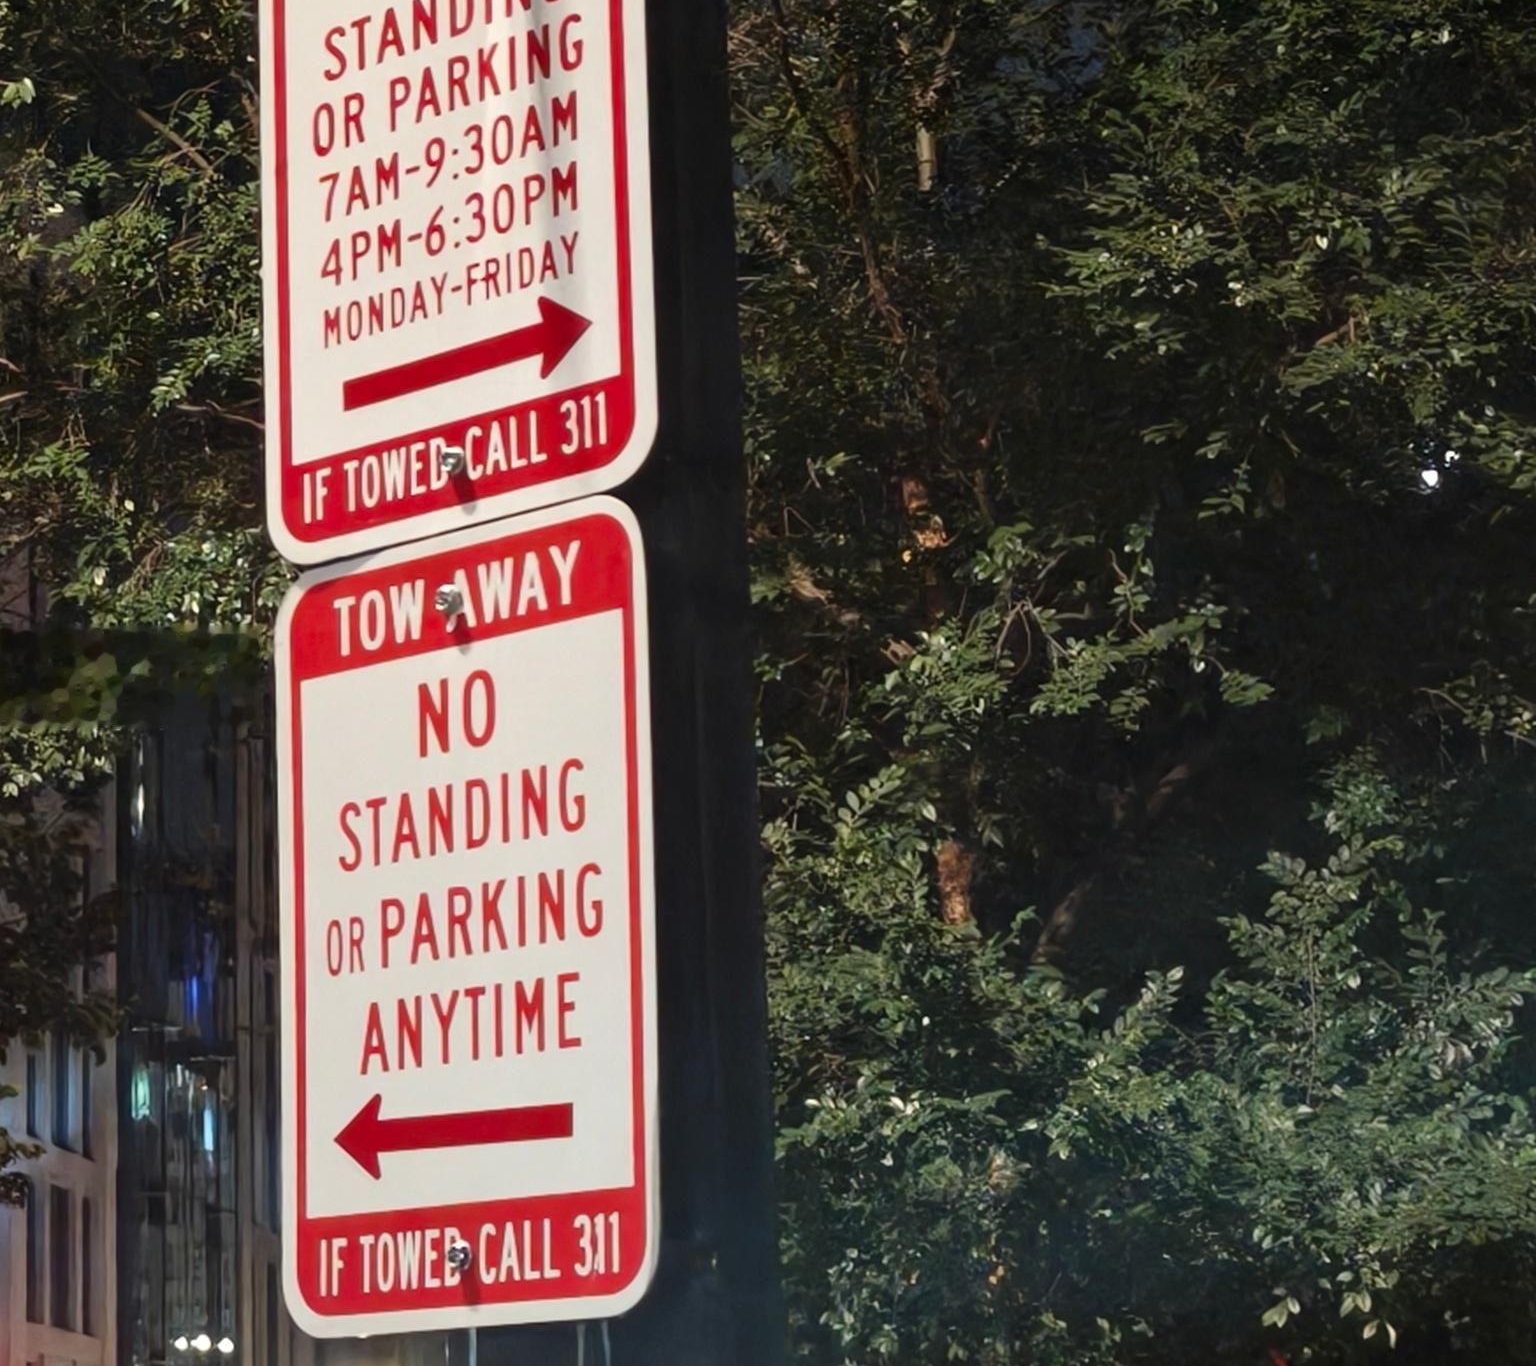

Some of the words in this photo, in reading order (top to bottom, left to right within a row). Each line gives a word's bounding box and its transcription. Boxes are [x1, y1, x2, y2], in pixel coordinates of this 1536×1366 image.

[313, 94, 364, 157] OR
[388, 13, 584, 132] PARKING
[320, 90, 579, 222] 7AM-9:30AM
[320, 162, 579, 286] 4PM-6:30PM
[324, 232, 579, 348] MONDAY-FRIDAY
[302, 467, 329, 525] IF
[344, 438, 451, 513] TOWED
[464, 413, 547, 480] CALL
[560, 391, 608, 454] 311
[333, 578, 424, 656] TOW
[448, 541, 581, 632] AWAY
[417, 669, 496, 758] NO
[338, 757, 586, 872] STANDING
[326, 915, 366, 977] OR
[379, 863, 603, 969] PARKING
[359, 971, 582, 1076] ANYTIME
[320, 1238, 346, 1296] IF
[359, 1226, 463, 1294] TOWED
[480, 1217, 560, 1285] CALL
[574, 1212, 621, 1278] 311
